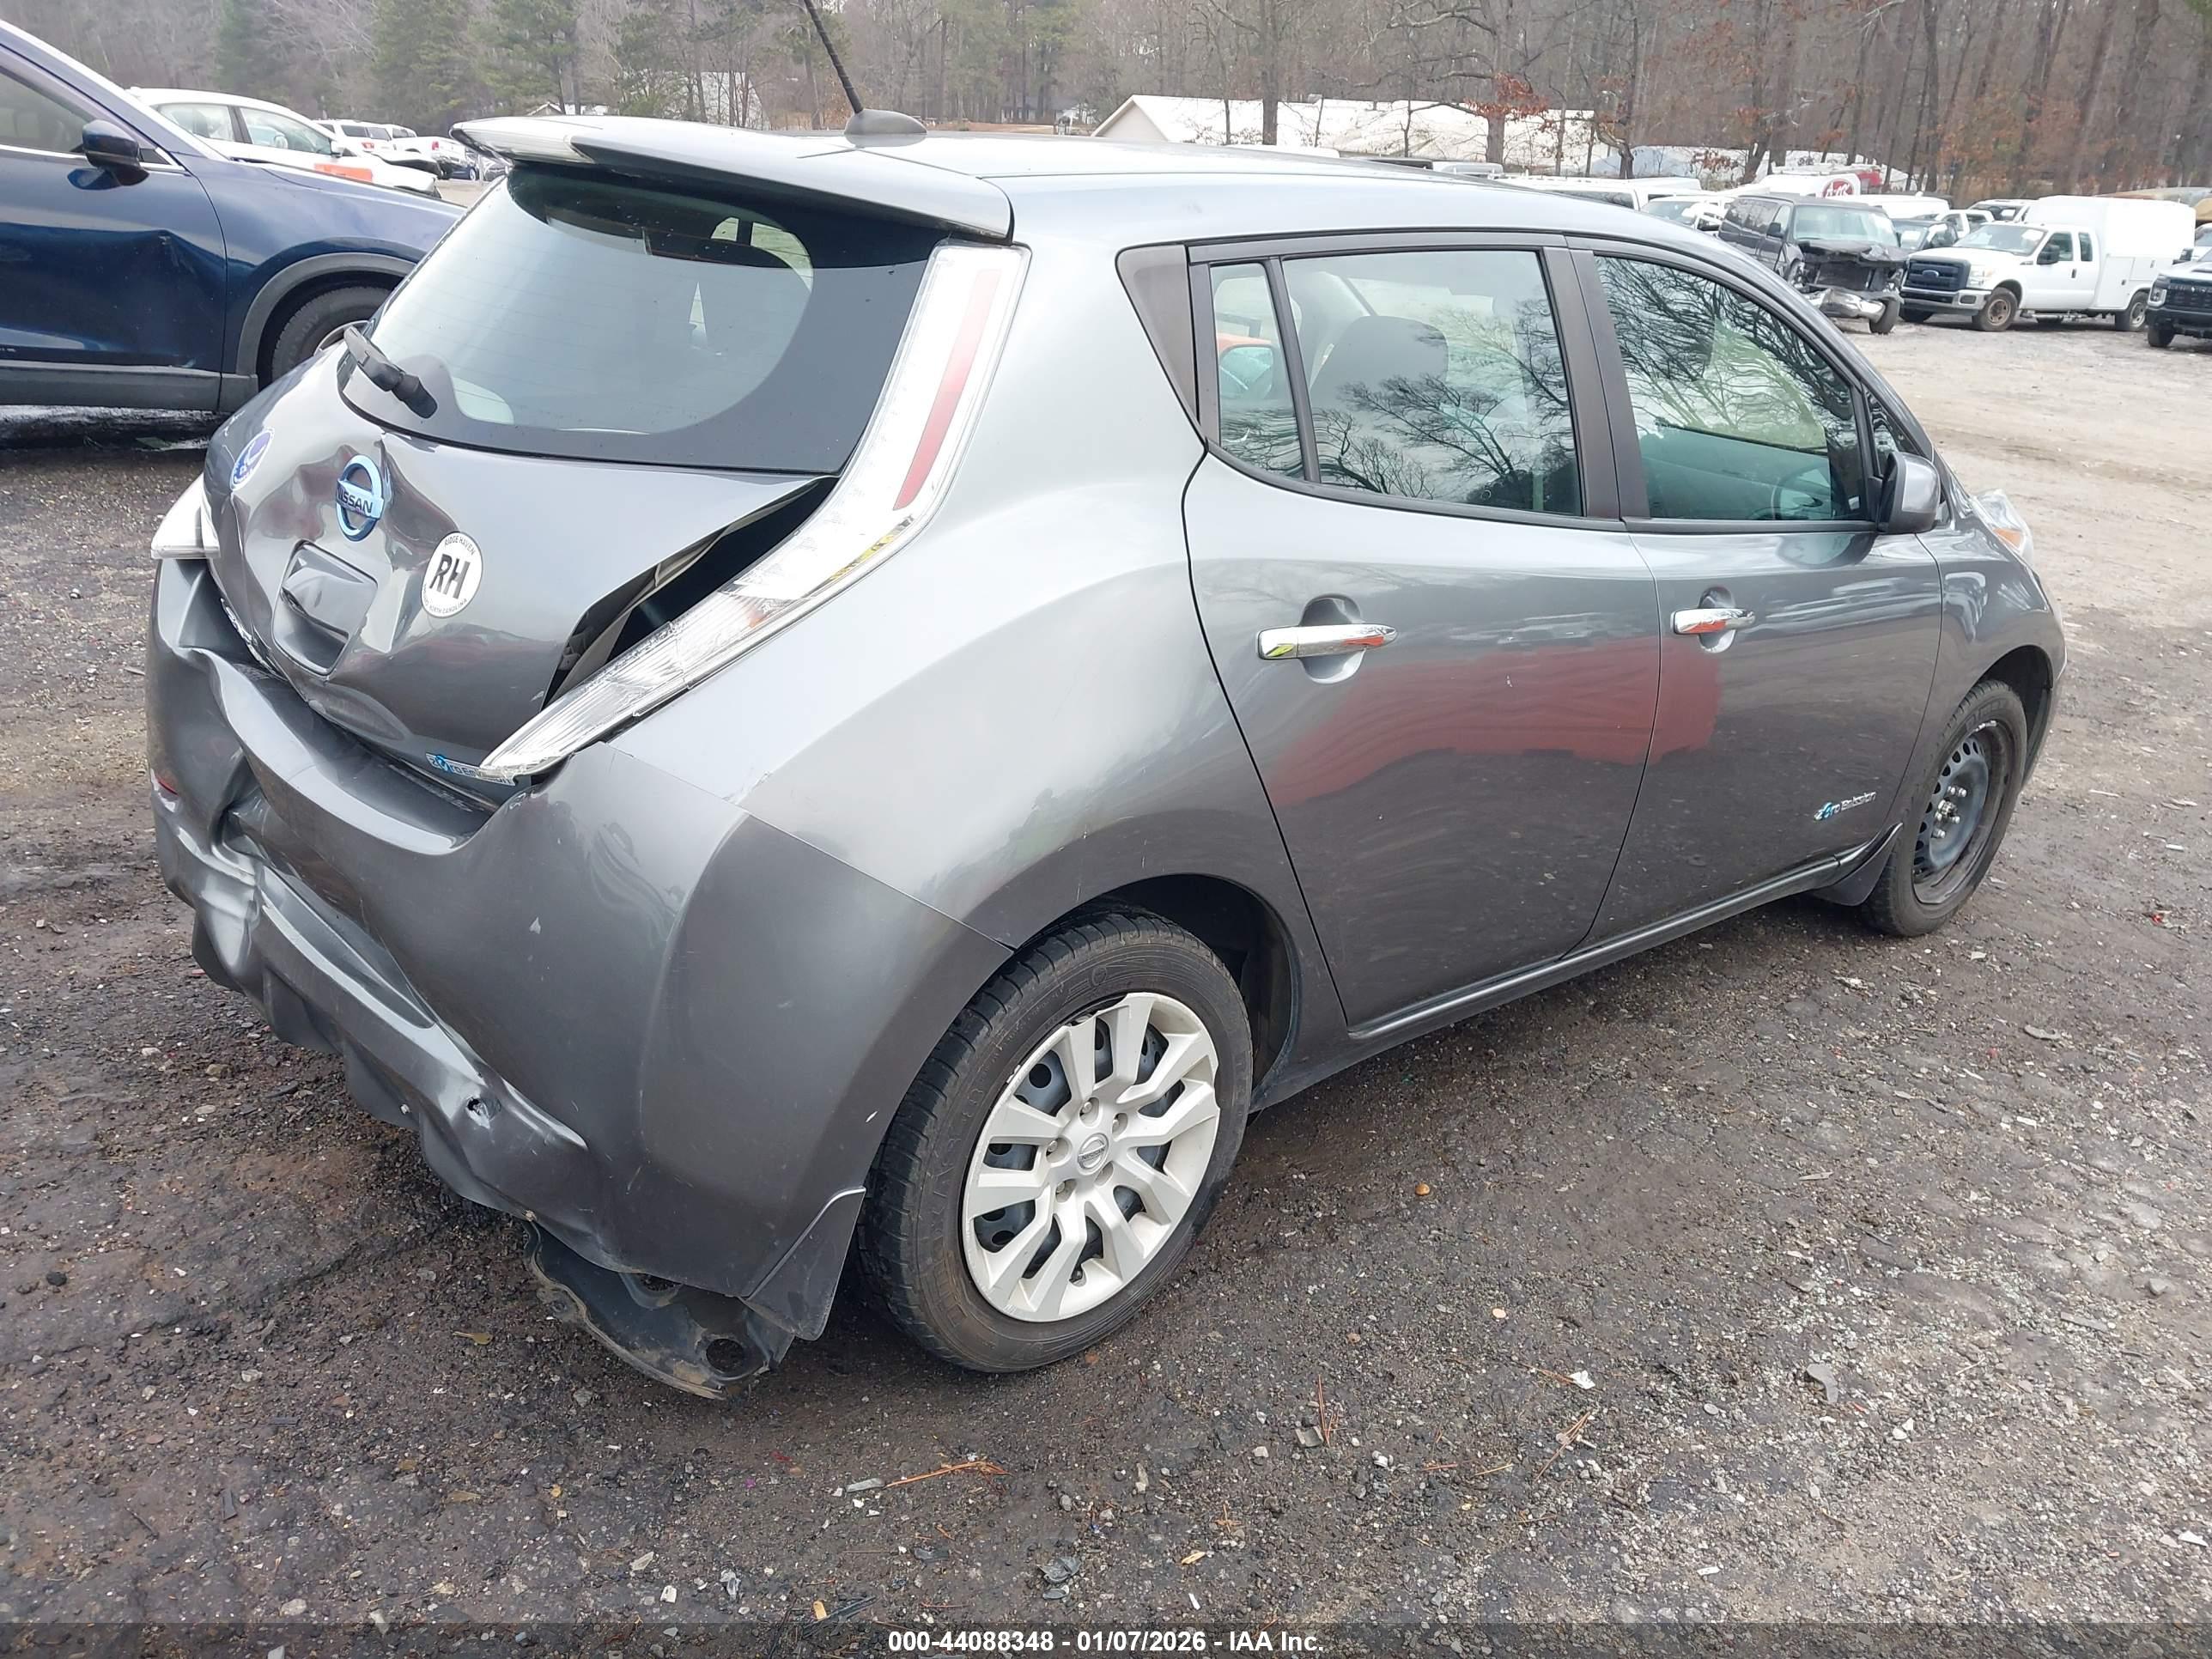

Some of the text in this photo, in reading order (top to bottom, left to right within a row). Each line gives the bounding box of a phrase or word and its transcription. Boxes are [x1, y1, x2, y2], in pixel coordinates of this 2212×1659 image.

[338, 483, 373, 514] NISSAN
[445, 535, 477, 556] RIDGE HAVEN
[429, 554, 471, 599] RH
